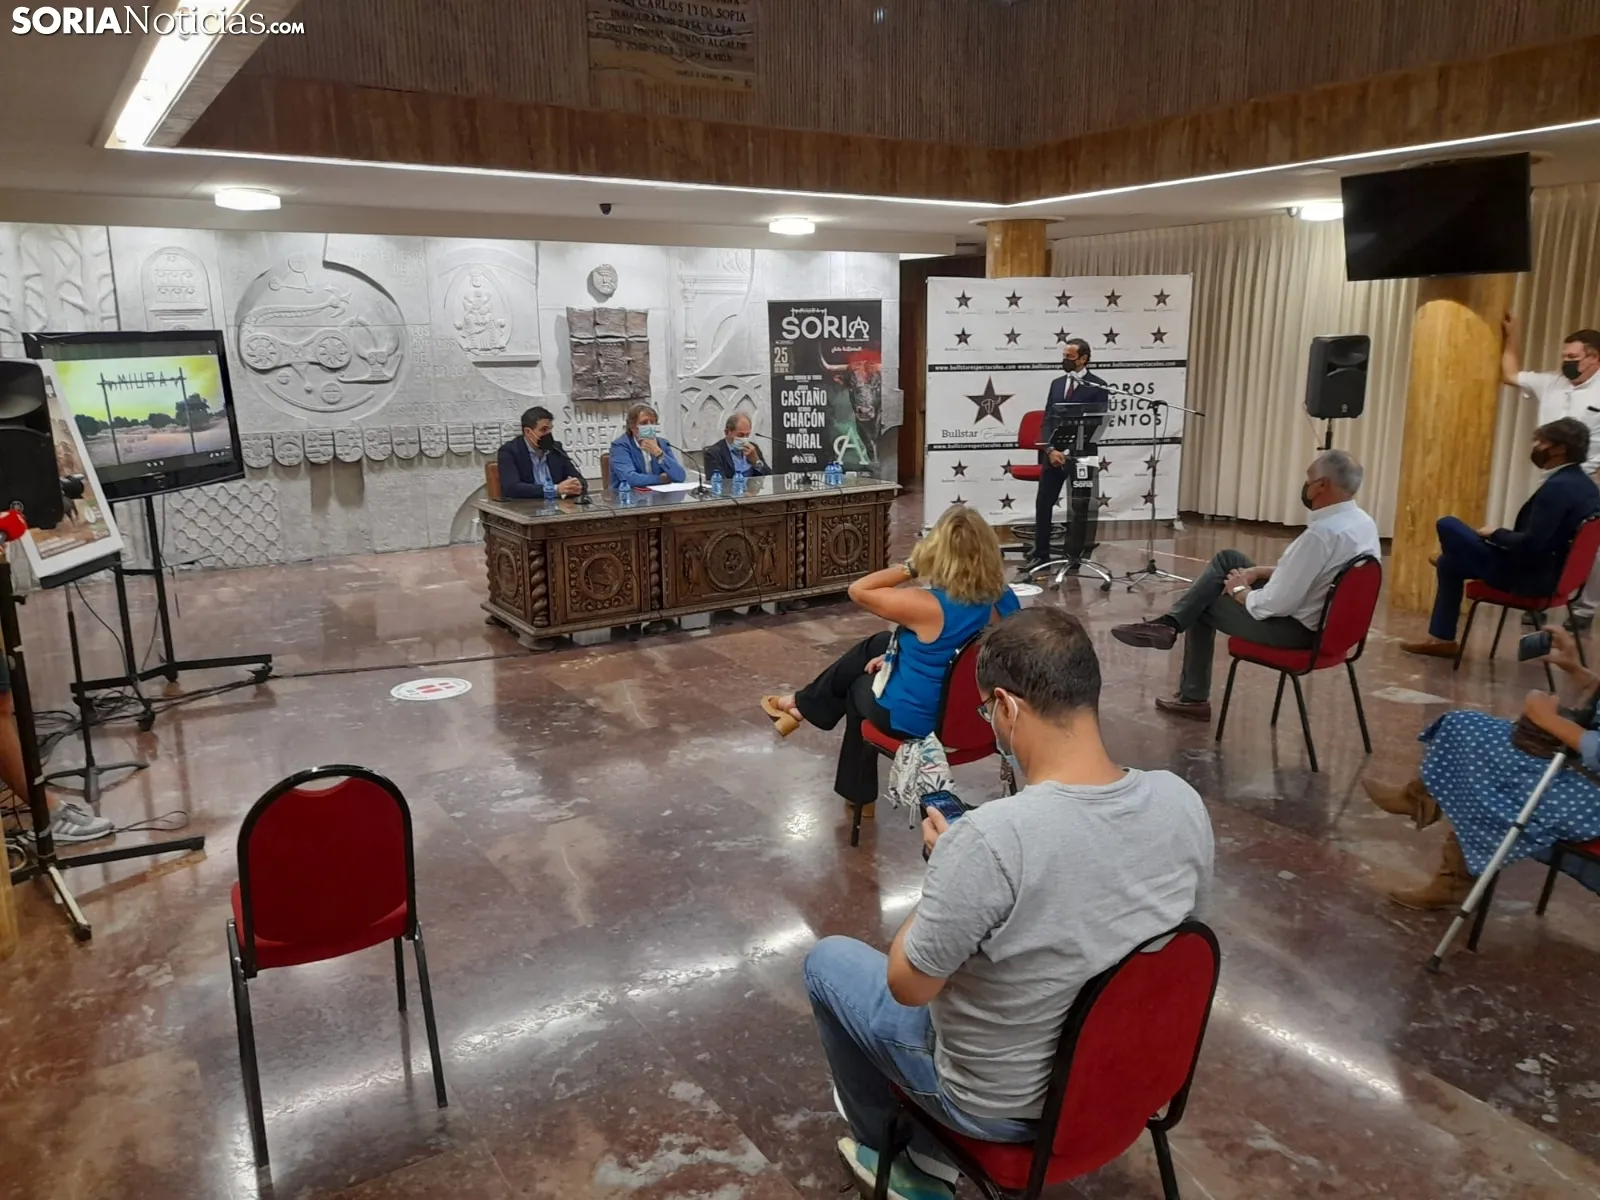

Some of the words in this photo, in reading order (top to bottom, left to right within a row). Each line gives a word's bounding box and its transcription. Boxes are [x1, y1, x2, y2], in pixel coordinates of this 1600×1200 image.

[781, 315, 870, 340] SORIA
[773, 346, 789, 364] 25
[117, 370, 167, 392] MIURA
[1108, 381, 1156, 396] OROS
[780, 386, 828, 407] CASTAÑO
[783, 408, 827, 428] CHACÓN
[785, 433, 823, 450] MORAL
[941, 429, 979, 439] Bullstar
[1072, 480, 1093, 488] Soria
